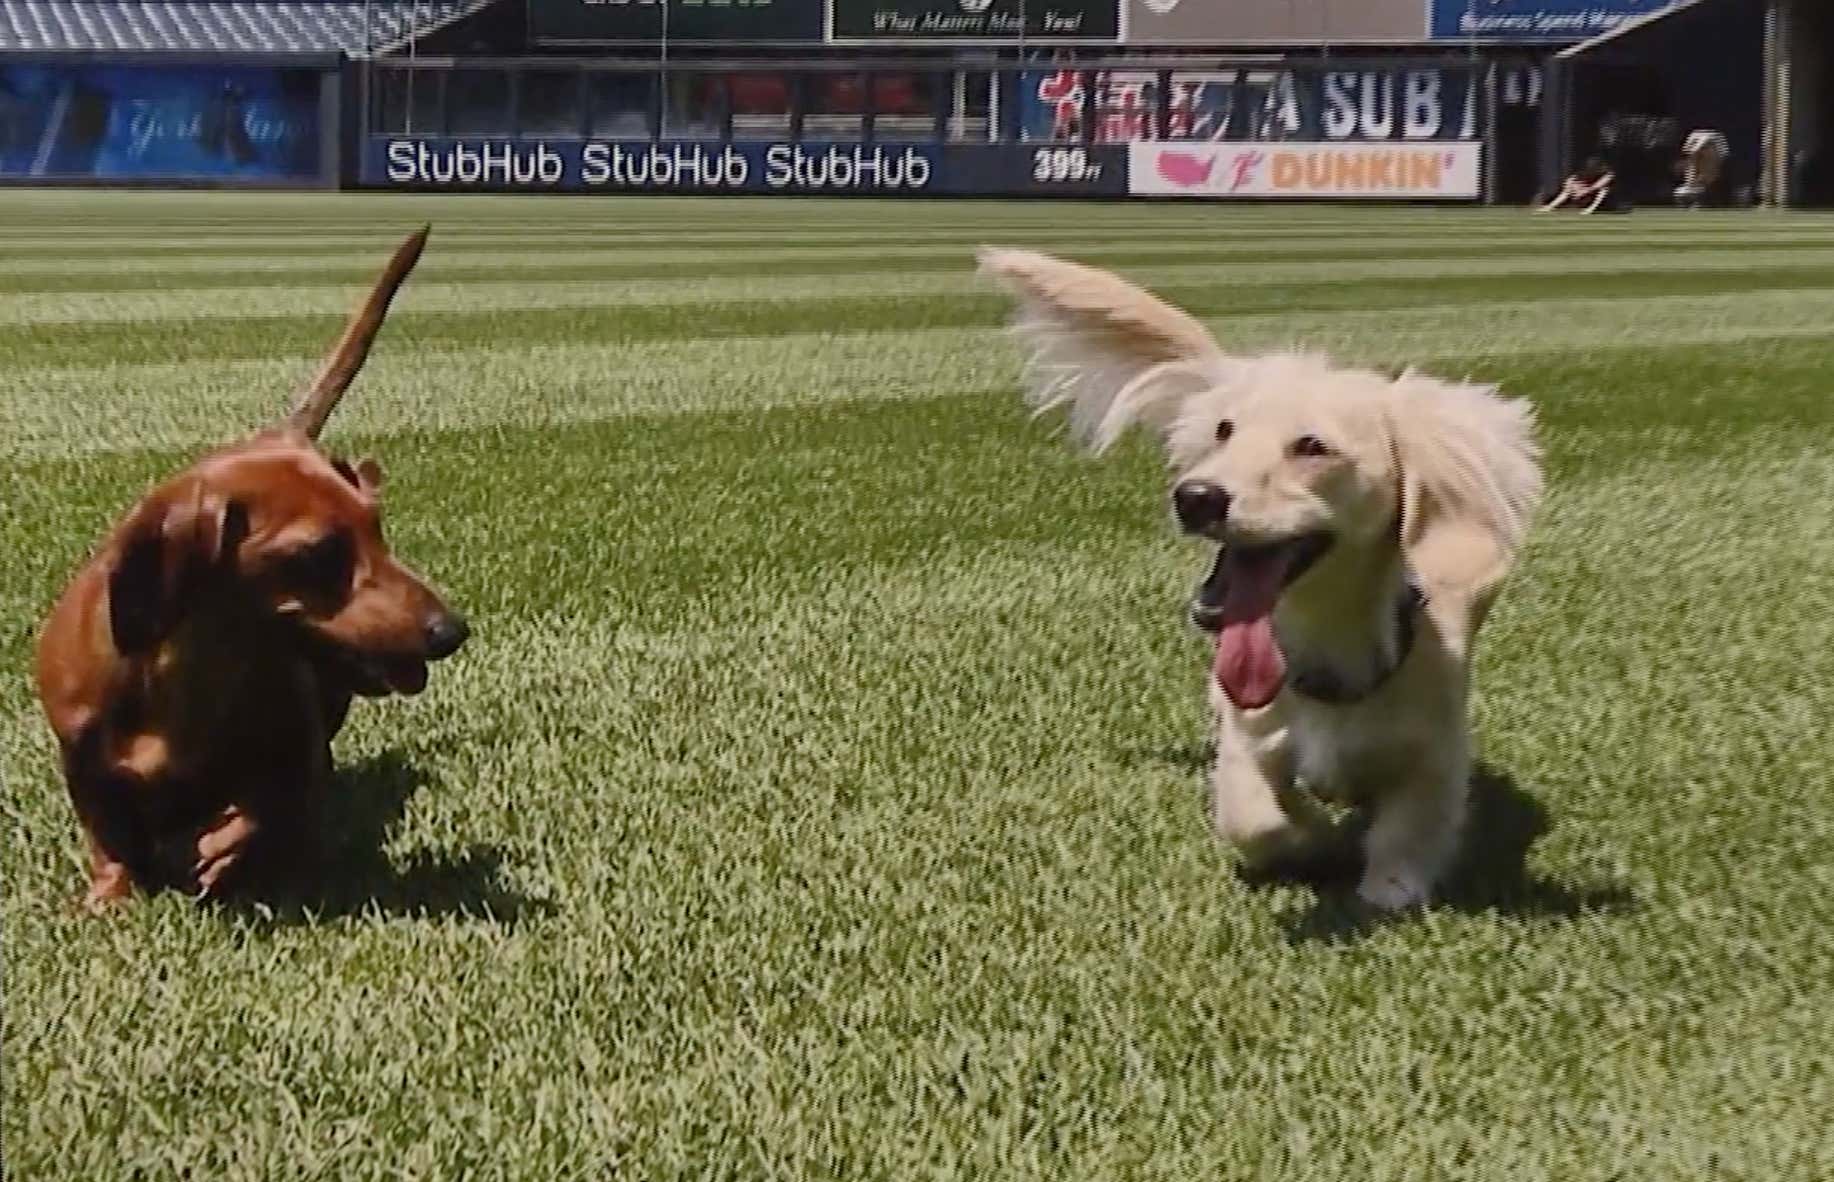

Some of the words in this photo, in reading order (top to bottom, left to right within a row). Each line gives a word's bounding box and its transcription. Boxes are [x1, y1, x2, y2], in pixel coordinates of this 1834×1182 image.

[1044, 10, 1083, 32] You!
[1321, 71, 1441, 139] SUB
[387, 140, 563, 183] StubHub
[581, 143, 748, 186] StubHub
[765, 144, 931, 188] StubHub
[1271, 152, 1456, 190] DUNKIN'
